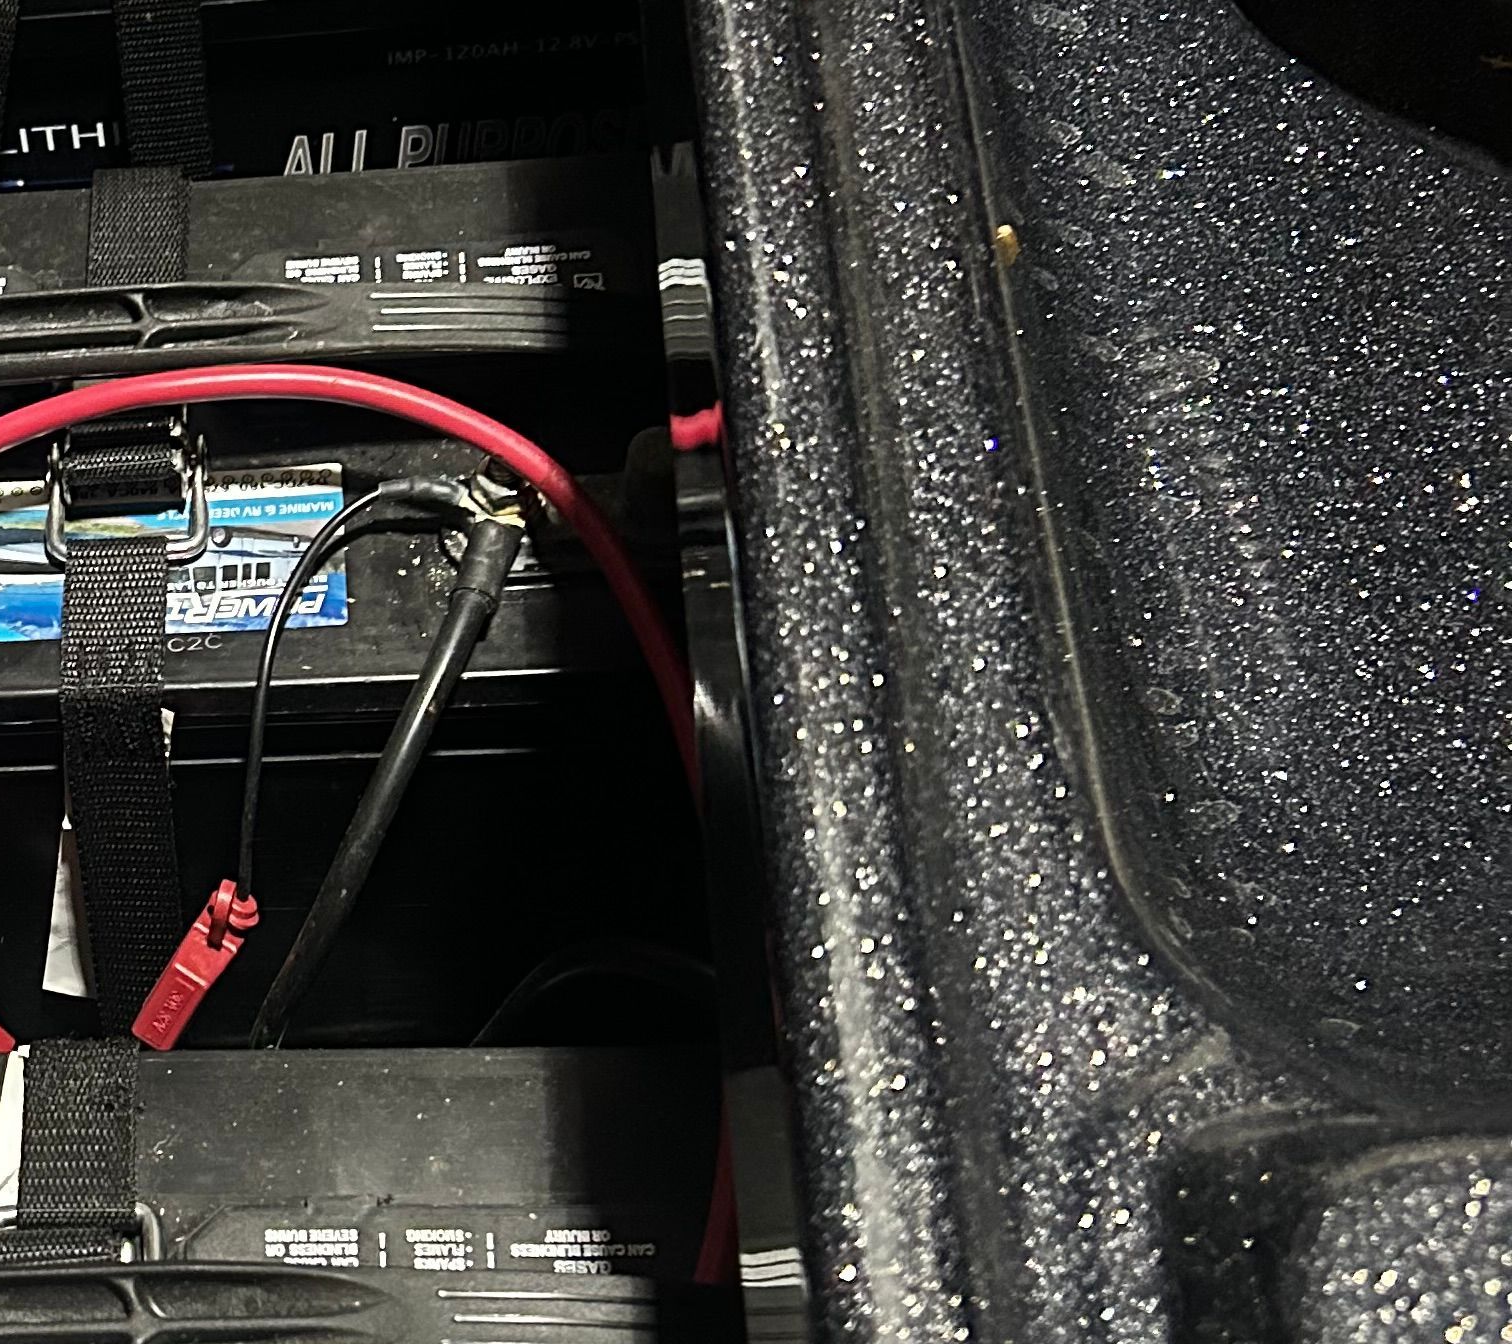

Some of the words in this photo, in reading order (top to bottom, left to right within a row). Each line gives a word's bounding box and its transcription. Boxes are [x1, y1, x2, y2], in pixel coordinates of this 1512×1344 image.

[237, 506, 262, 518] RV
[278, 500, 335, 516] MARINE
[265, 1229, 308, 1244] BURNS
[309, 1230, 359, 1244] SEVERE
[406, 1229, 466, 1243] SMOKING
[544, 1229, 589, 1243] INJURY
[589, 1230, 610, 1243] OR
[265, 1243, 287, 1257] OR
[289, 1244, 359, 1258] BLINDNESS
[414, 1244, 466, 1257] FLAMES
[510, 1244, 581, 1258] BLINDNESS
[582, 1244, 625, 1257] CAUSE
[626, 1244, 656, 1256] CAN
[414, 1258, 466, 1271] SPARKS
[553, 1260, 612, 1274] GASES
